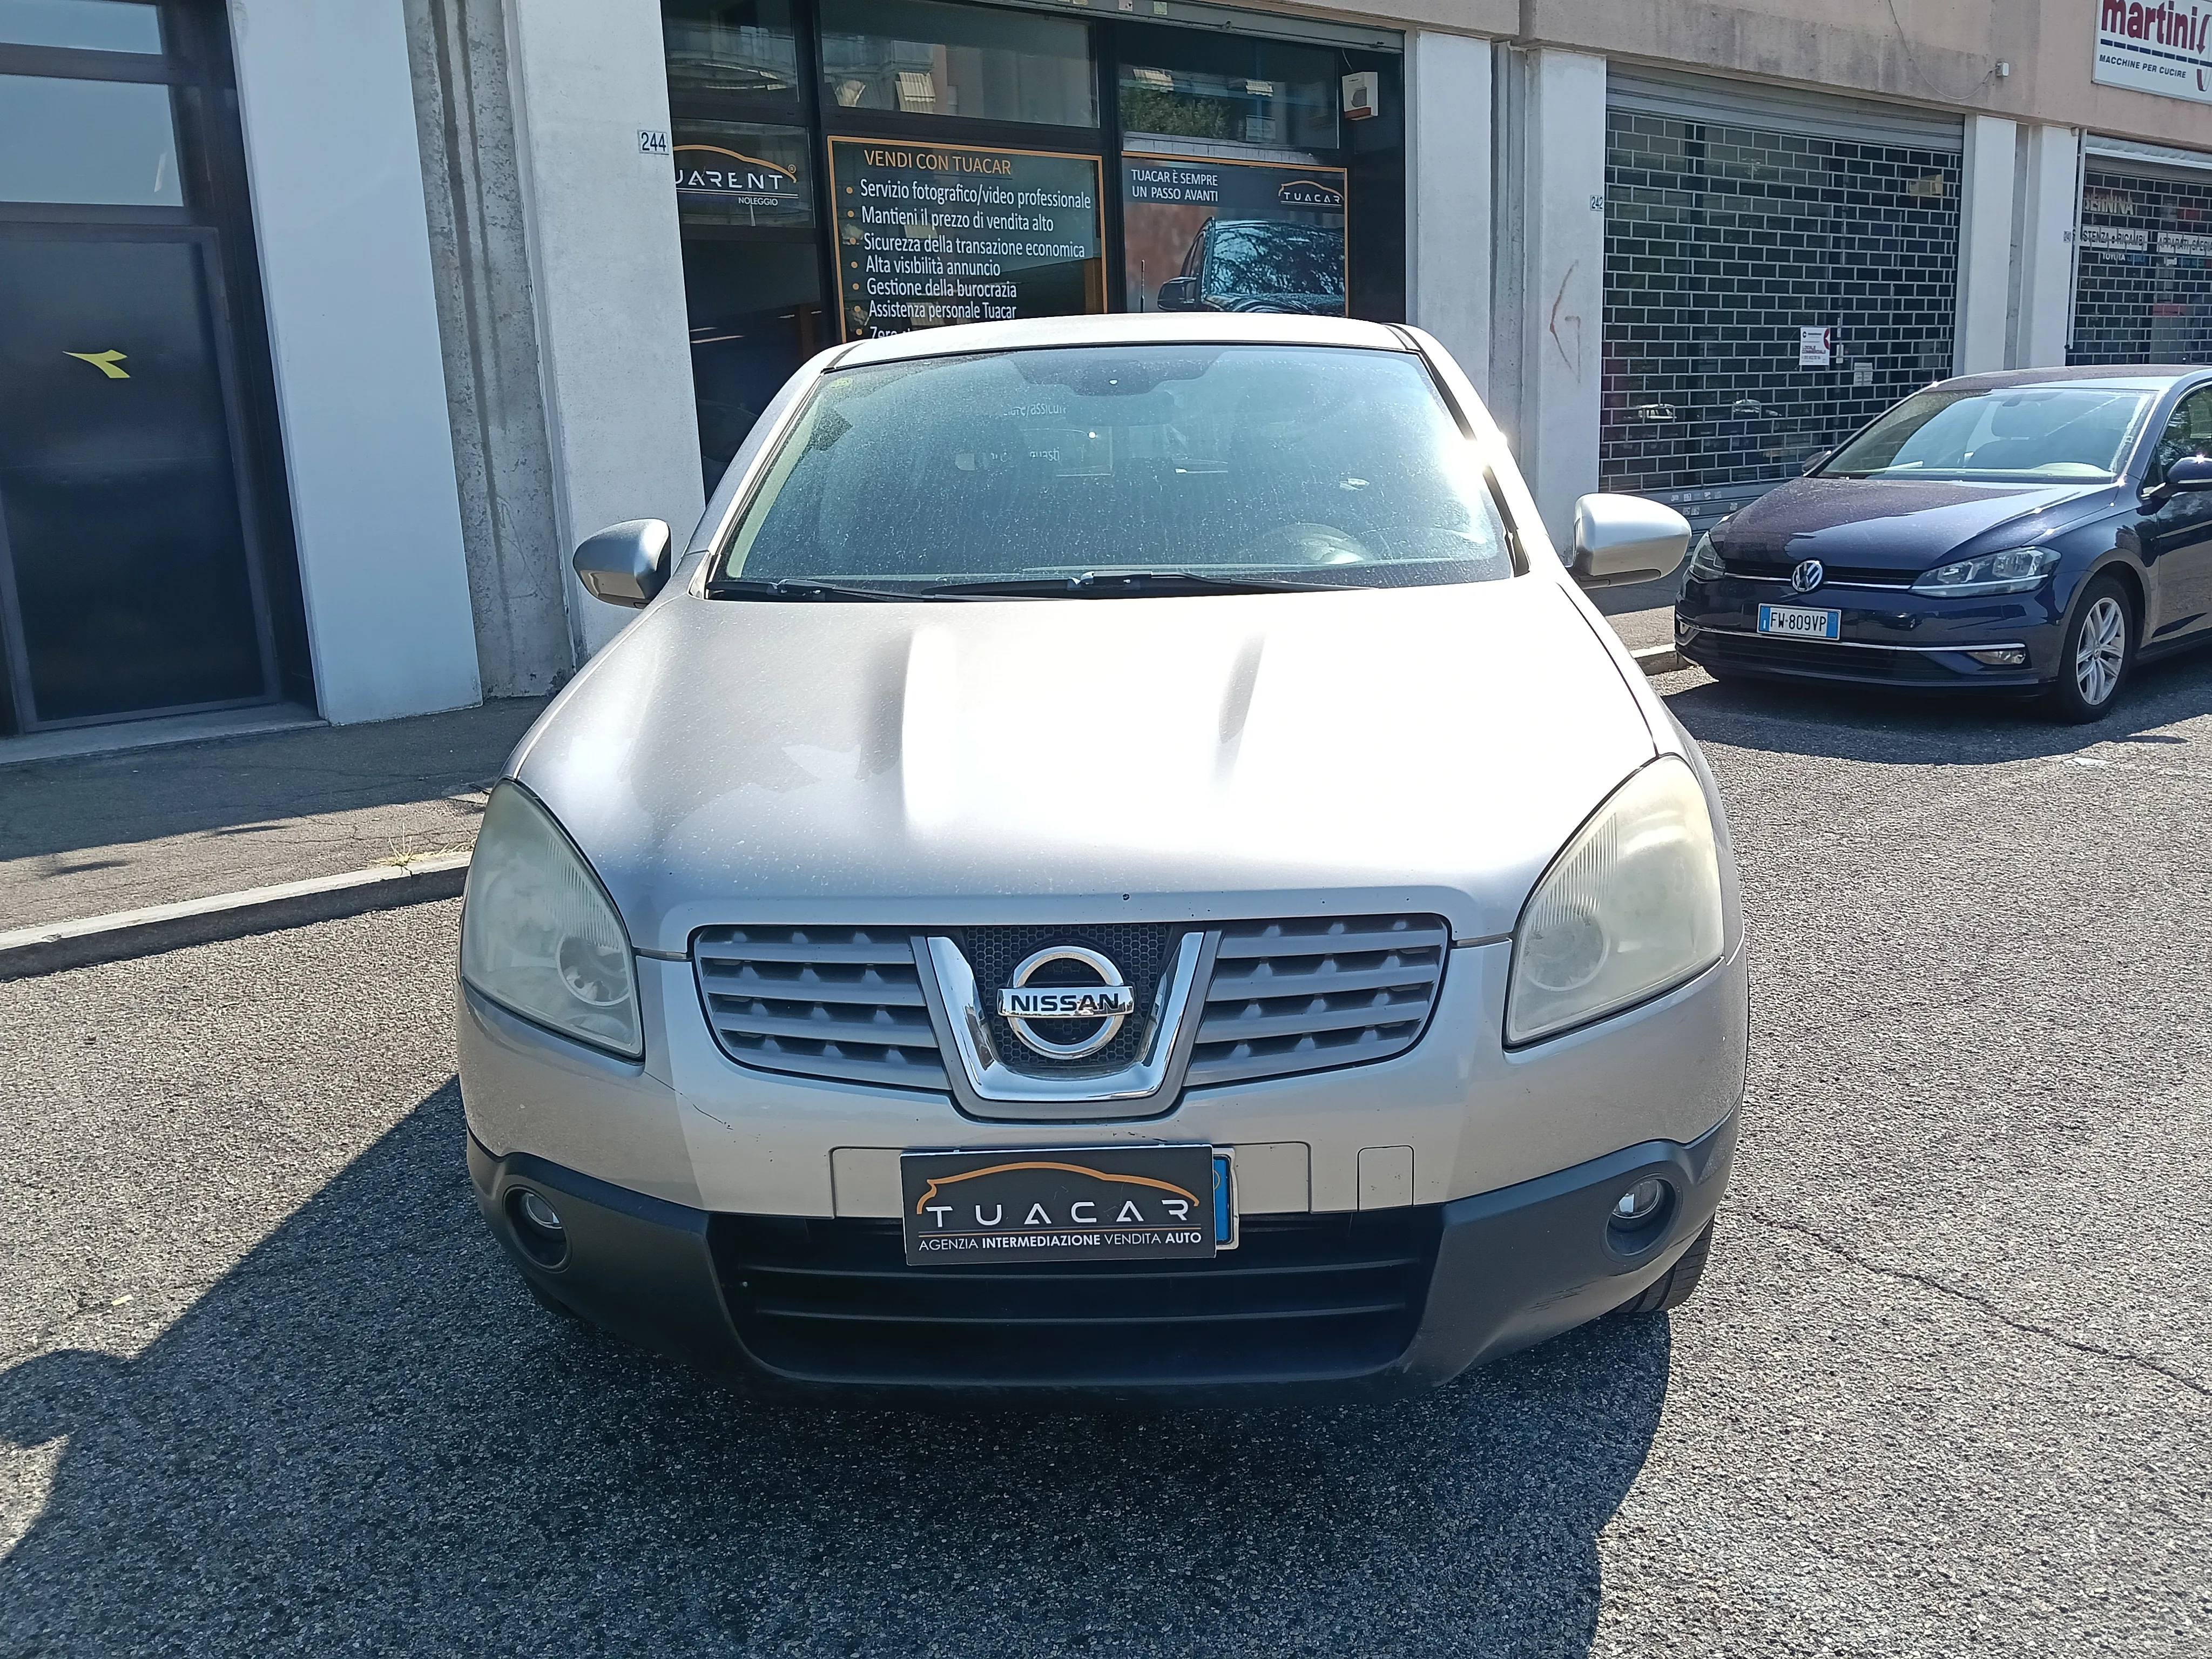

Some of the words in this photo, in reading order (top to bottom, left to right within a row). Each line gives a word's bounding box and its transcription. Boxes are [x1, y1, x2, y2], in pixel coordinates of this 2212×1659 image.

[2101, 0, 2197, 50] martini
[2099, 54, 2140, 69] MACCHINE
[2142, 63, 2157, 73] PER
[2159, 66, 2187, 78] CUCIRE
[641, 132, 666, 151] 244
[865, 150, 912, 168] VENDI
[916, 153, 948, 171] CON
[953, 156, 1011, 175] TUACAR
[1131, 169, 1170, 183] TUACAR
[1172, 169, 1178, 184] È
[1180, 173, 1218, 186] SEMPRE
[738, 197, 778, 206] NOLEGGIO
[861, 179, 909, 199] Servizio
[912, 180, 1014, 205] fotografico/video
[1017, 191, 1091, 210] professionale
[1132, 185, 1147, 198] UN
[1151, 187, 1181, 200] PASSO
[1184, 188, 1218, 202] AVANTI
[1284, 192, 1340, 203] TUACAR
[1591, 196, 1603, 210] 242
[862, 206, 918, 226] Mantieni
[921, 209, 928, 226] il
[932, 213, 970, 230] prezzo
[973, 212, 984, 228] di
[986, 213, 1029, 231] vendita
[1033, 214, 1053, 232] alto
[864, 232, 920, 252] Sicurezza
[924, 235, 953, 254] della
[956, 238, 1022, 256] transazione
[1026, 241, 1084, 258] economica
[866, 255, 891, 273] Alta
[894, 256, 943, 275] visibilità
[947, 260, 1000, 276] annuncio
[867, 278, 921, 296] Gestione
[925, 279, 953, 297] della
[957, 280, 1017, 298] burocrazia
[868, 300, 926, 319] Assistenza
[928, 302, 980, 321] personale
[982, 302, 1016, 319] Tuacar
[1011, 993, 1118, 1011] NISSAN
[926, 1199, 1188, 1228] TUACAR
[919, 1237, 979, 1251] AGENZIA
[982, 1234, 1101, 1249] INTERMEDIAZIONE
[1103, 1232, 1162, 1245] VENDITA
[1165, 1232, 1202, 1244] AUTO
